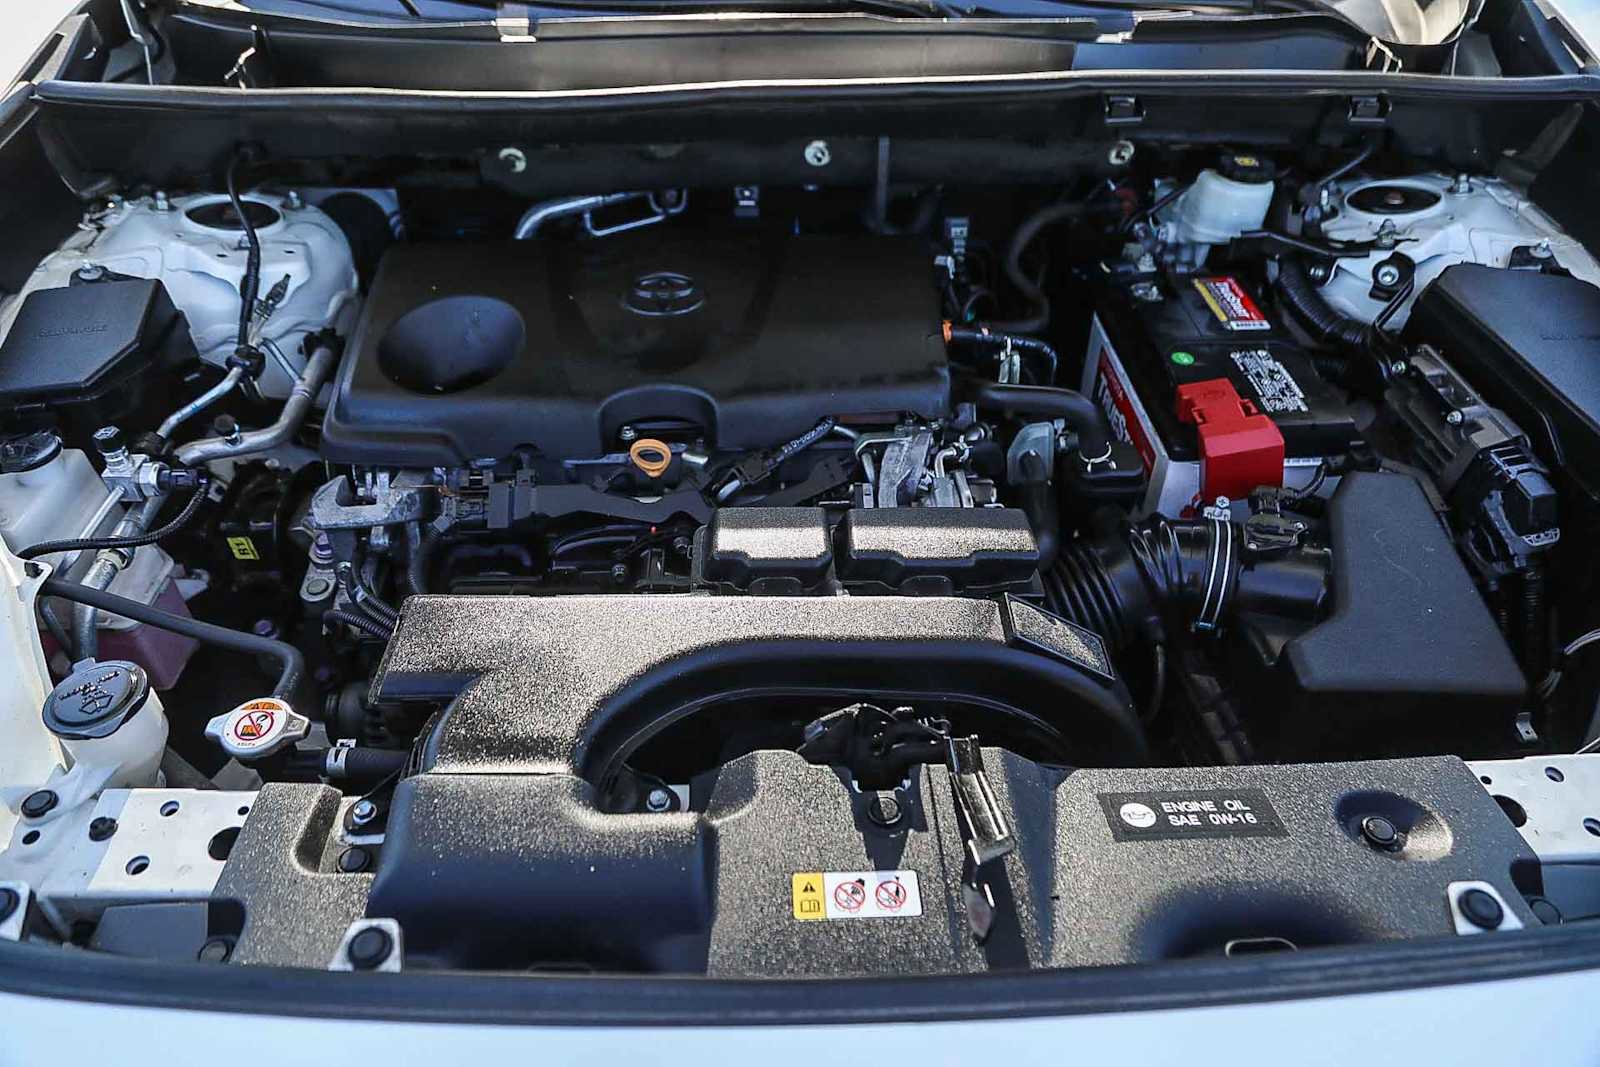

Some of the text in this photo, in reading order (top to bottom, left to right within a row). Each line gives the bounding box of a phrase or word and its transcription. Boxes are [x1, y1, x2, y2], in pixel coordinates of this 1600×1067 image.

[1161, 800, 1251, 812] ENGINE OIL
[1168, 812, 1258, 826] SAE 0W-16
